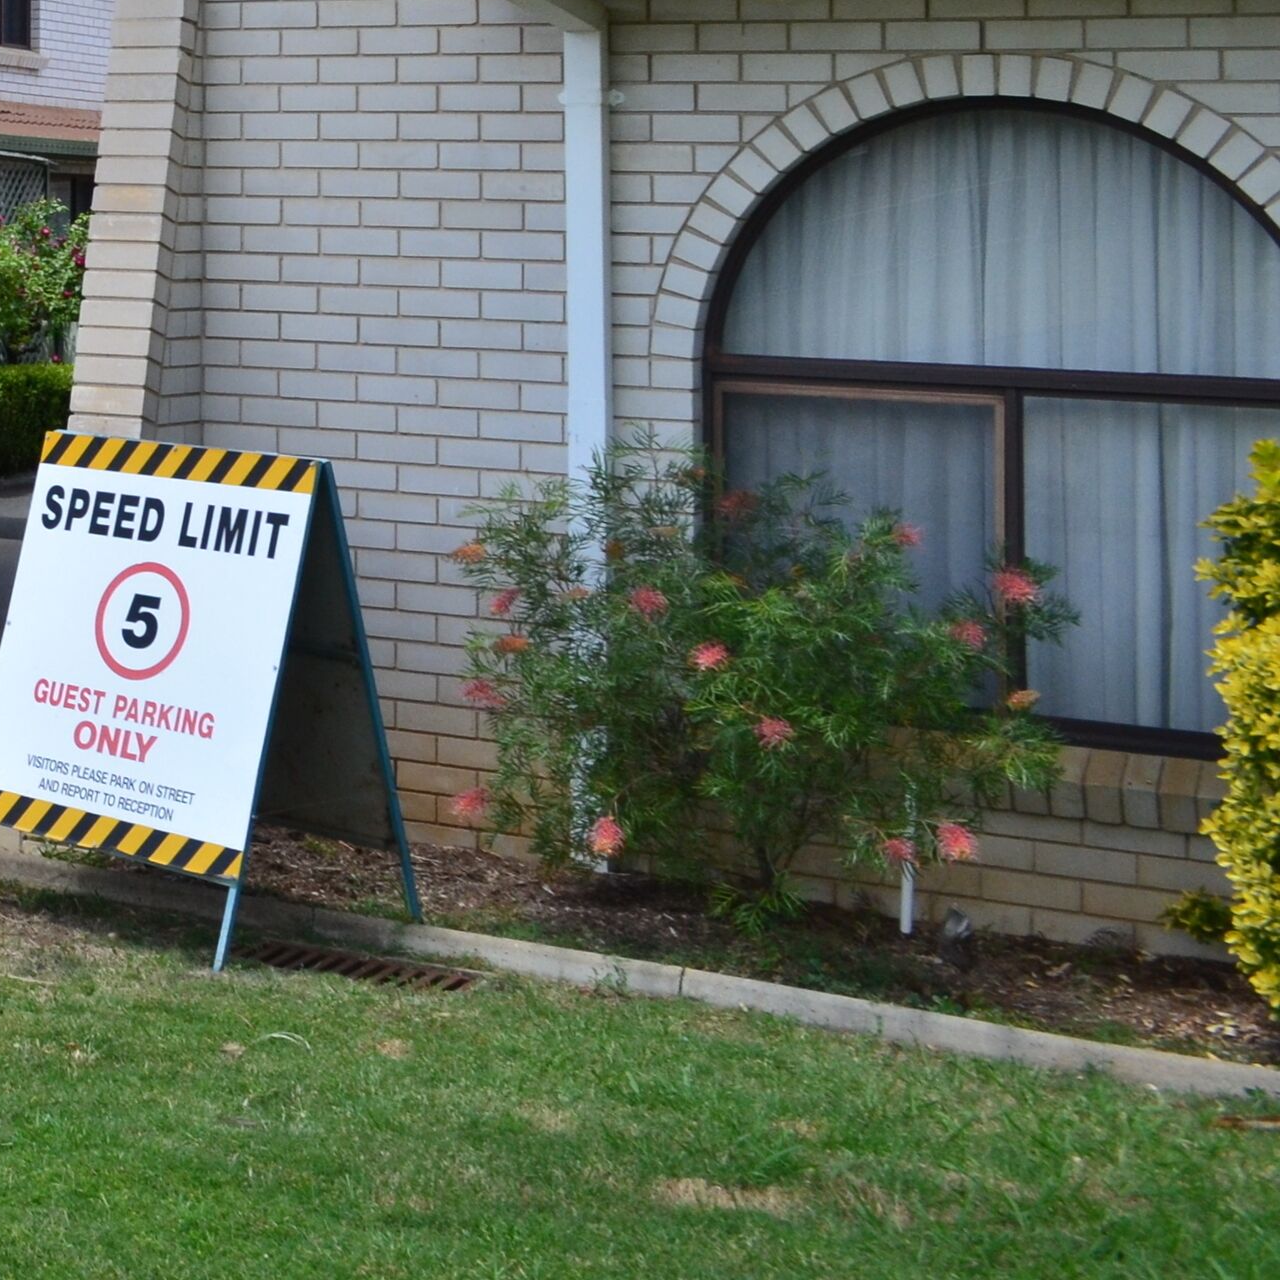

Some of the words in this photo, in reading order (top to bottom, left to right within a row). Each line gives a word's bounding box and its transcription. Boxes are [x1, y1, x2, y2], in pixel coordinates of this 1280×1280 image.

[41, 484, 165, 543] SPEED
[177, 501, 290, 560] LIMIT
[121, 592, 162, 650] 5
[33, 678, 107, 716] GUEST
[112, 693, 216, 740] PARKING
[73, 720, 158, 764] ONLY
[27, 753, 70, 776] VISITORS
[70, 764, 109, 786] PLEASE
[109, 773, 137, 792] PARK
[138, 780, 154, 796] ON
[155, 784, 196, 806] STREET
[38, 777, 60, 793] AND
[60, 782, 101, 804] REPORT
[103, 791, 116, 807] TO
[117, 796, 175, 822] RECEPTION
